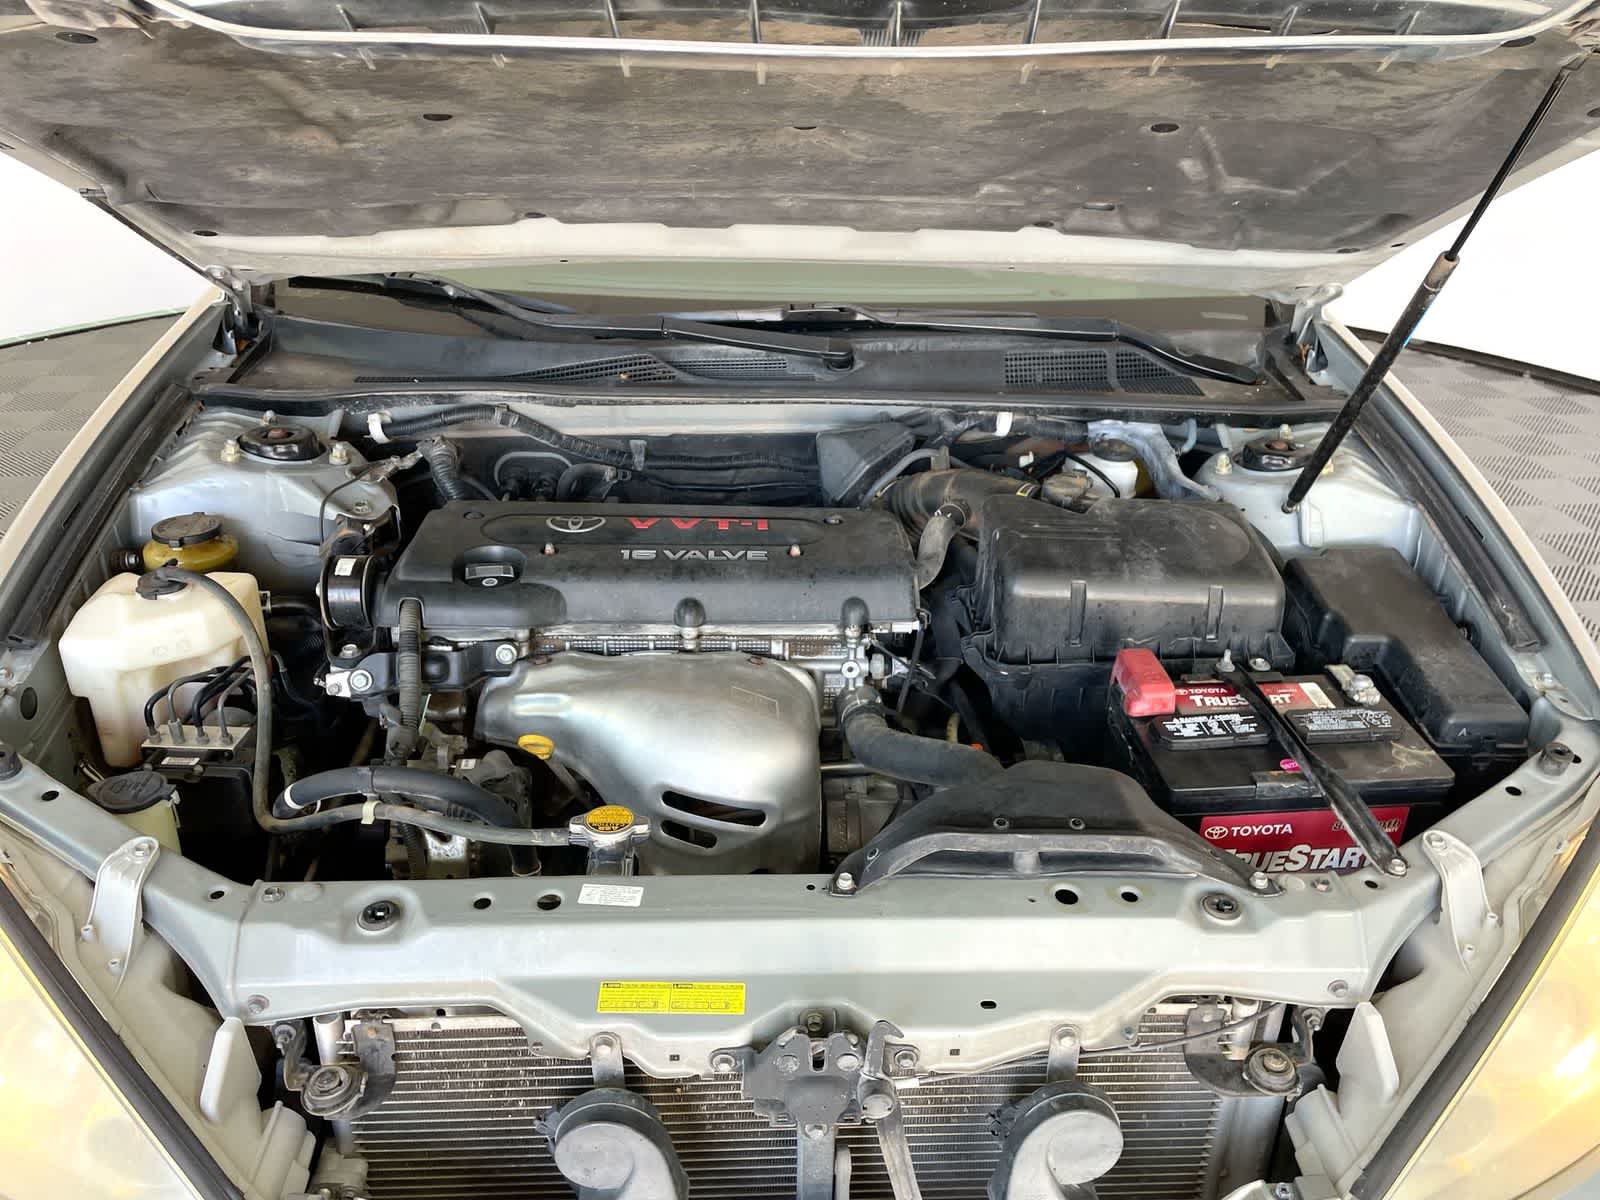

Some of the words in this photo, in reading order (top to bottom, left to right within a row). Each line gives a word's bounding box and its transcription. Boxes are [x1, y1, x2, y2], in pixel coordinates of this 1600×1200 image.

[620, 549, 657, 560] 16
[663, 549, 769, 561] VALVE
[1188, 687, 1229, 695] TOYOTA
[1231, 823, 1293, 837] TOYOTA
[1224, 844, 1370, 872] UESTAR
